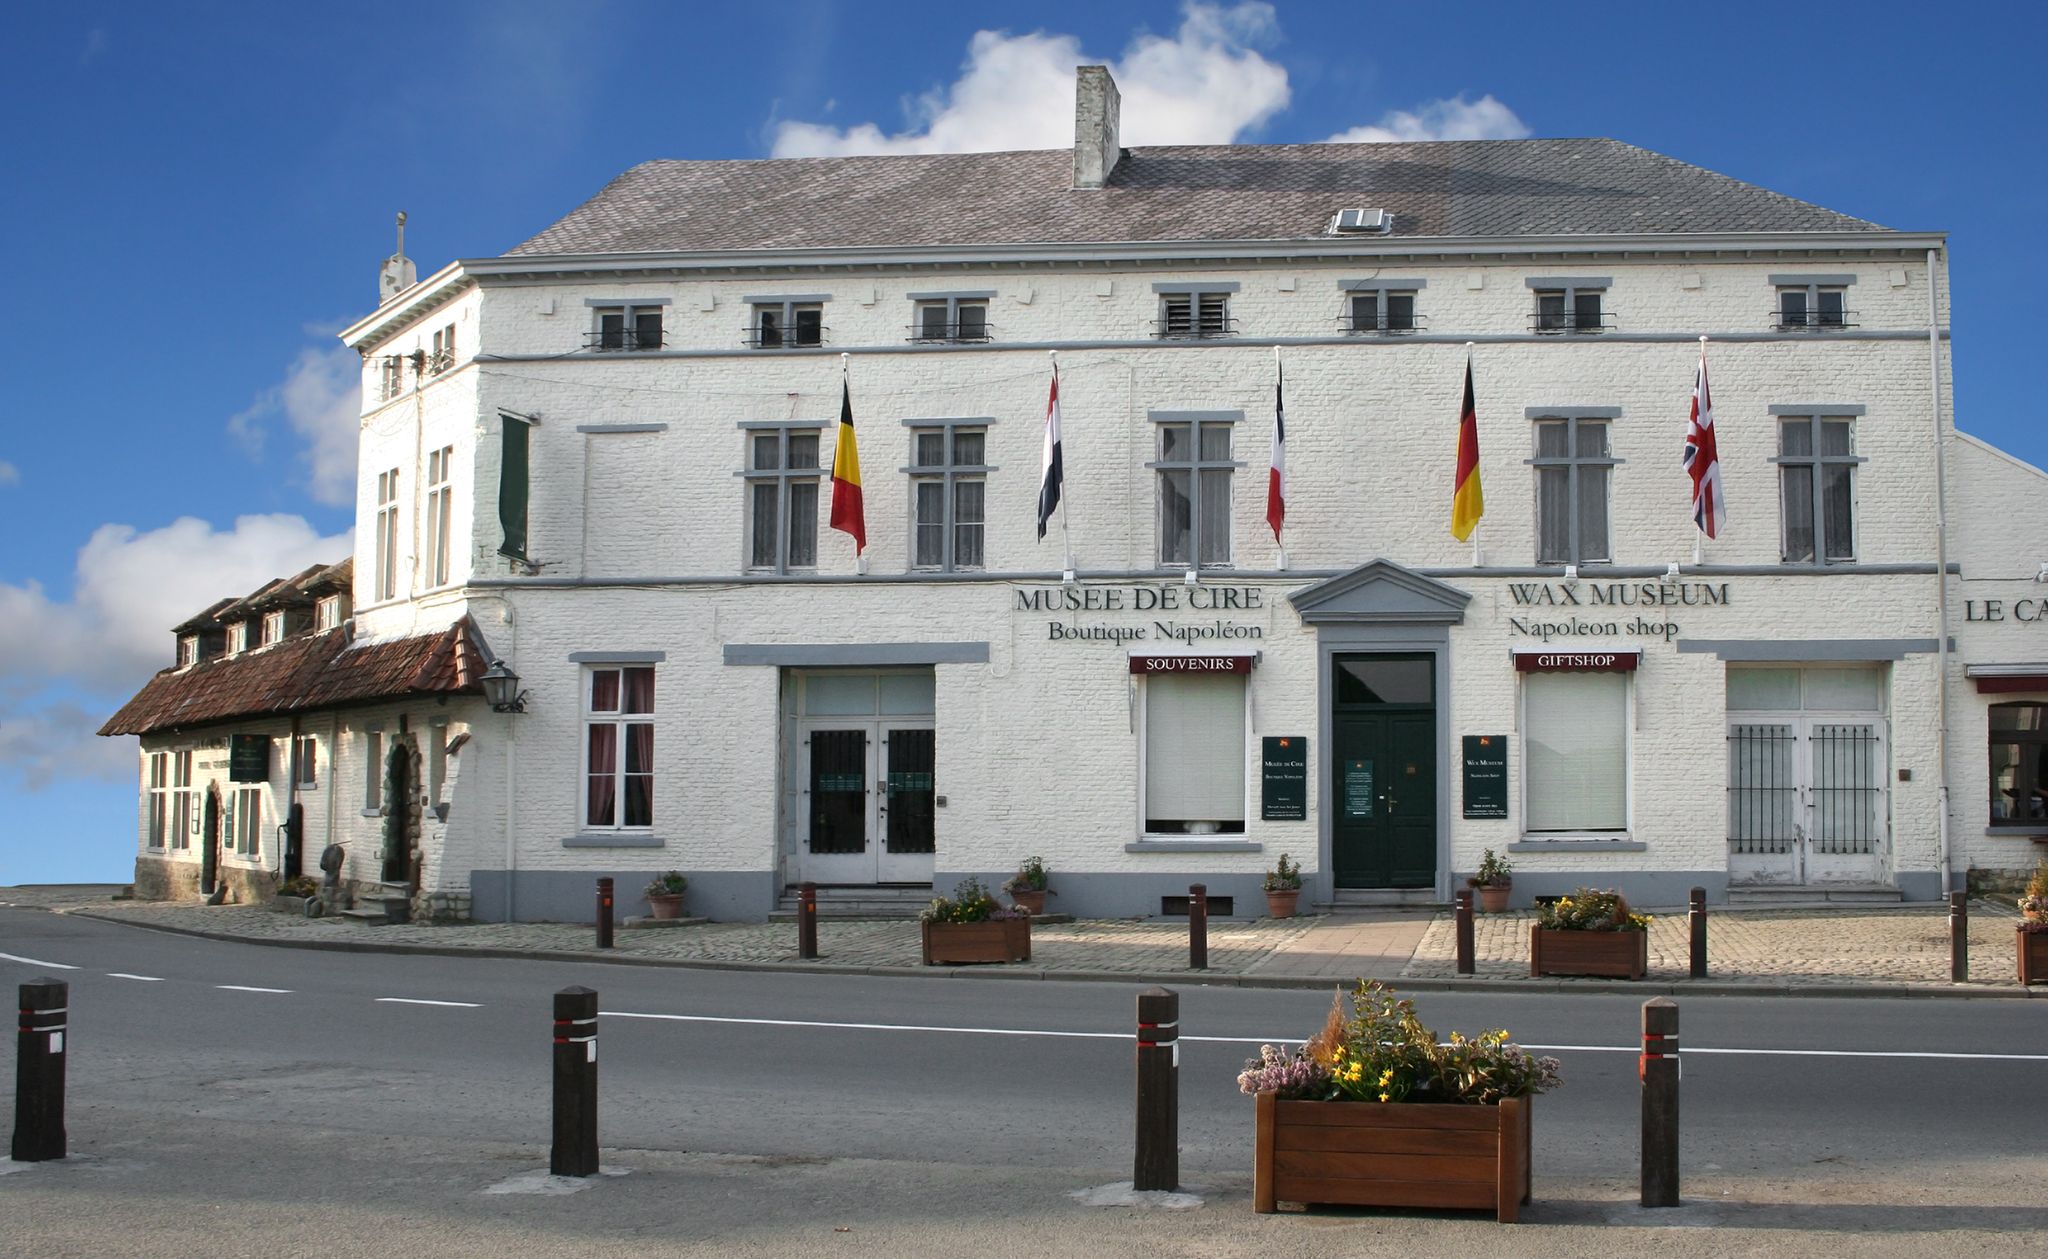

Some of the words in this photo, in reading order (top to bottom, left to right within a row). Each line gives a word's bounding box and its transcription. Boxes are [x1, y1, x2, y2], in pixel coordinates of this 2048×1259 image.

[1016, 588, 1124, 611] MUSEE
[1132, 587, 1180, 610] DE
[1189, 587, 1264, 609] CIRE
[1508, 583, 1581, 606] WAX
[1589, 583, 1730, 606] MUSEUM
[1964, 600, 2005, 622] LE
[1048, 621, 1146, 646] Boutique
[1153, 620, 1263, 646] Napoléon
[1508, 616, 1618, 643] Napoleon
[1625, 616, 1679, 643] shop
[1146, 658, 1234, 670] SOUVENIRS
[1538, 655, 1616, 667] GIFTSHOP
